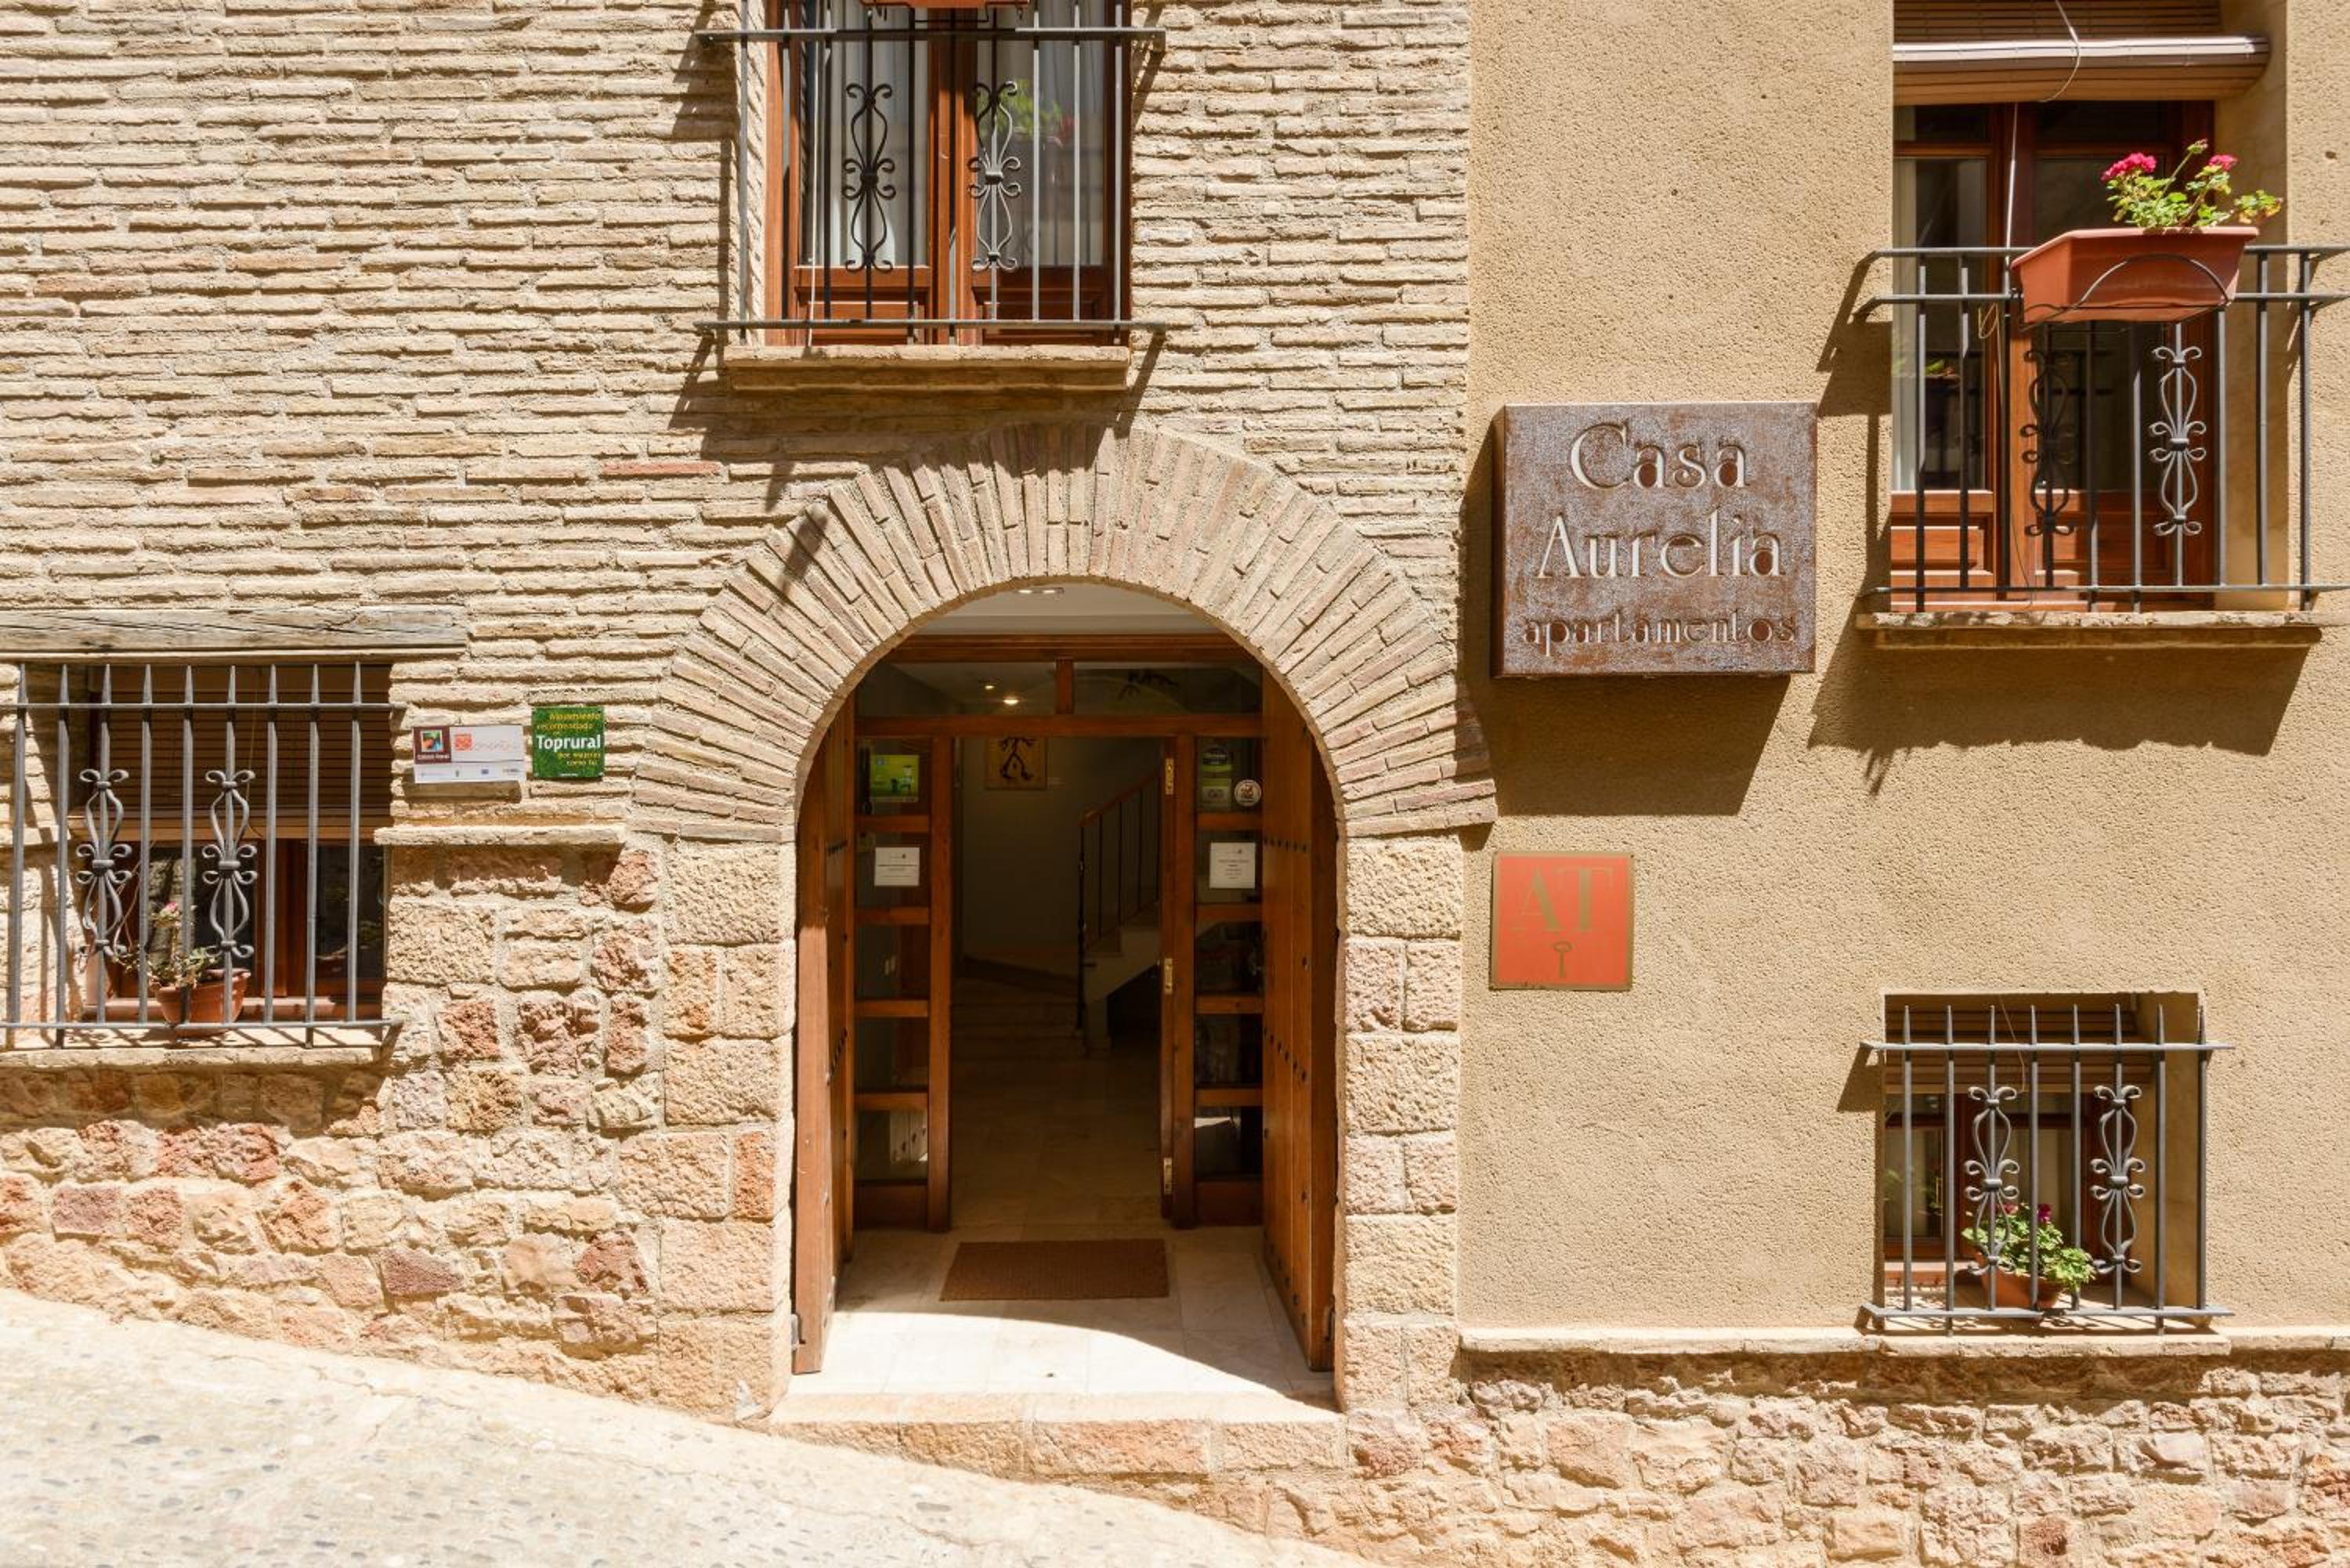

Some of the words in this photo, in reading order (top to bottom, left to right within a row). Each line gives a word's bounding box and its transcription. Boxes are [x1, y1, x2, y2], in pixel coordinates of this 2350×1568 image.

[1570, 421, 1750, 490] Casa
[1538, 508, 1786, 579] Aurelia
[1523, 609, 1796, 656] apartamentos
[536, 734, 601, 752] Toprural
[1506, 865, 1615, 932] AT
